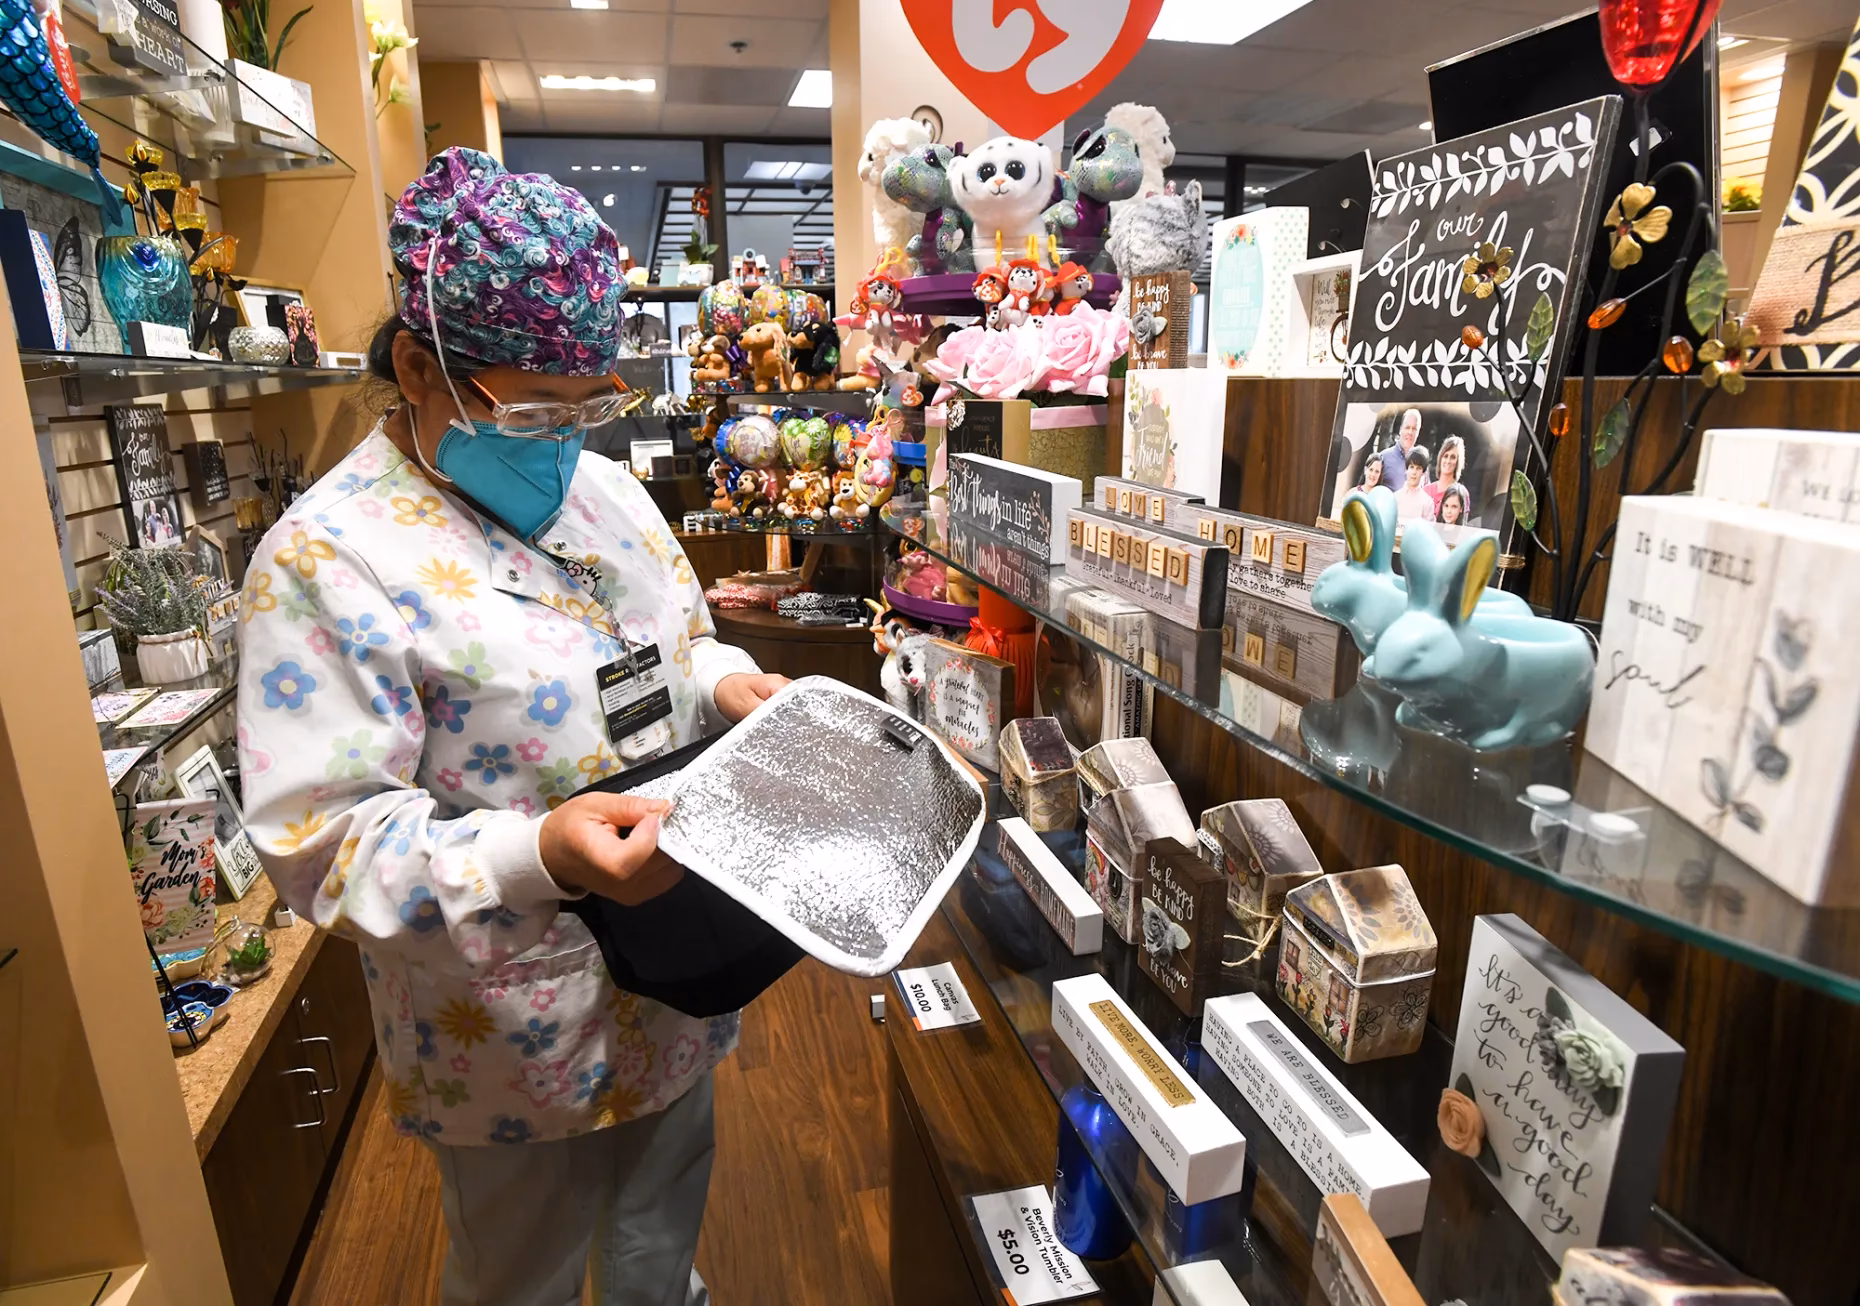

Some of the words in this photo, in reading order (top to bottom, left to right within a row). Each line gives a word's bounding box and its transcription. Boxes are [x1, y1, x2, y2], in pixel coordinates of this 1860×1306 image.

[134, 29, 184, 74] HEART
[1437, 212, 1484, 242] our
[1145, 279, 1170, 302] happy
[1359, 210, 1567, 336] Famly
[967, 473, 1001, 531] Things
[1001, 496, 1012, 522] in
[1014, 500, 1032, 530] life
[1107, 489, 1160, 517] LOVE
[1007, 528, 1027, 547] aren't
[1027, 534, 1049, 560] things
[1071, 522, 1181, 579] BLESSED
[1200, 522, 1299, 566] HOME
[1635, 531, 1651, 555] It
[1659, 539, 1677, 562] is
[1689, 544, 1754, 585] WELL
[1238, 562, 1274, 582] gathers
[1250, 575, 1258, 589] to
[1260, 583, 1286, 599] share
[1628, 599, 1665, 627] with
[1672, 616, 1703, 643] my
[605, 669, 625, 683] STROKE
[1125, 681, 1135, 705] Song
[141, 861, 202, 905] Garden
[240, 860, 255, 880] BIG
[1147, 855, 1162, 882] be
[1163, 867, 1194, 920] happy
[1152, 883, 1162, 904] BE
[1165, 894, 1184, 921] KIND
[909, 983, 932, 1012] $10.00
[931, 978, 946, 998] Lunch
[940, 998, 952, 1011] Bag
[943, 981, 959, 1005] Canvas
[1150, 957, 1159, 977] BE
[1158, 967, 1177, 994] YOU
[1478, 954, 1523, 1004] It's
[1098, 1002, 1120, 1026] LIVE
[1115, 1022, 1139, 1048] MORE,
[1136, 1047, 1164, 1075] WORRY
[1159, 1073, 1185, 1100] LESS
[1478, 1002, 1539, 1064] good
[1058, 1004, 1074, 1029] LIVE
[1075, 1027, 1084, 1043] BY
[1114, 1077, 1134, 1105] GROW
[1136, 1105, 1147, 1123] IN
[1085, 1053, 1103, 1080] WALK
[1105, 1079, 1115, 1096] IN
[1208, 1013, 1232, 1045] HAVING
[1243, 1053, 1266, 1084] PLACE
[1269, 1083, 1279, 1099] TO
[1281, 1099, 1293, 1115] GO
[1296, 1114, 1307, 1132] TO
[1312, 1132, 1323, 1150] IS
[1266, 1032, 1283, 1046] WE
[1281, 1049, 1304, 1069] ARE
[1302, 1072, 1349, 1121] BLESSED
[1205, 1022, 1229, 1055] HAVING
[1231, 1053, 1262, 1094] SOMEONE
[1265, 1092, 1275, 1109] TO
[1278, 1109, 1299, 1137] LOVE
[1301, 1136, 1312, 1155] IS
[1214, 1046, 1240, 1081] HAVING
[1246, 1085, 1265, 1112] BOTH
[1271, 1116, 1282, 1133] IS
[1473, 1028, 1507, 1071] to
[1507, 1070, 1578, 1161] have
[1482, 1088, 1512, 1119] a
[1512, 1115, 1593, 1198] good
[1020, 1206, 1029, 1215] &
[1507, 1162, 1580, 1236] day
[997, 1228, 1030, 1276] $5.00
[1024, 1215, 1042, 1246] Vision
[1032, 1207, 1053, 1244] Beverly
[1050, 1245, 1073, 1280] Mission
[1038, 1246, 1064, 1285] Tumbler
